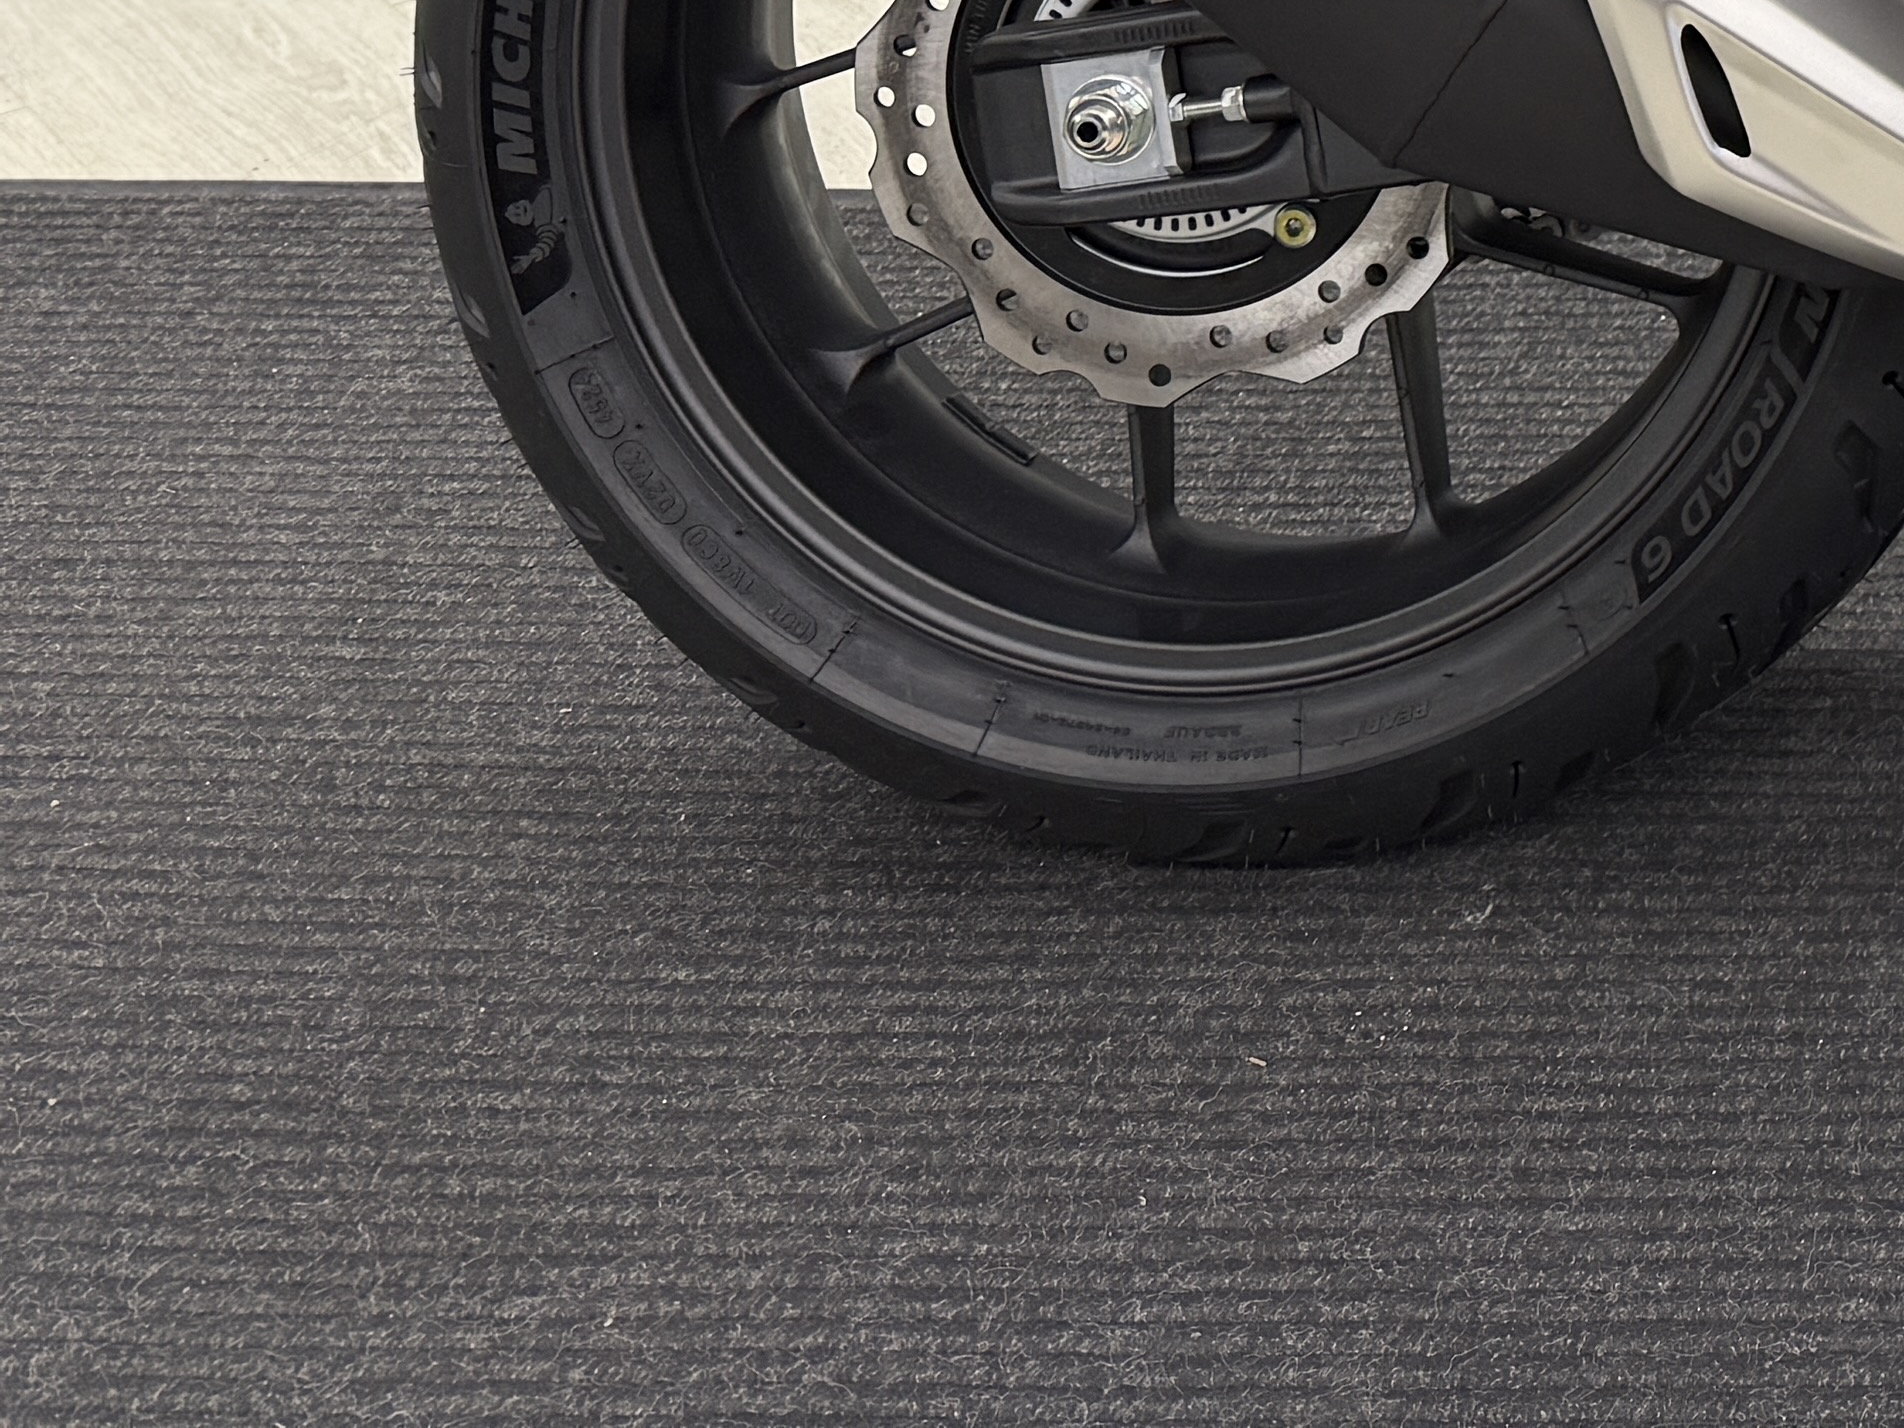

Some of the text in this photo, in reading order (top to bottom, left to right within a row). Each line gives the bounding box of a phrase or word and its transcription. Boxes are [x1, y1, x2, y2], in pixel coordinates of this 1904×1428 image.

[1641, 377, 1786, 583] ROAD 6
[1084, 745, 1177, 763] THAILAND
